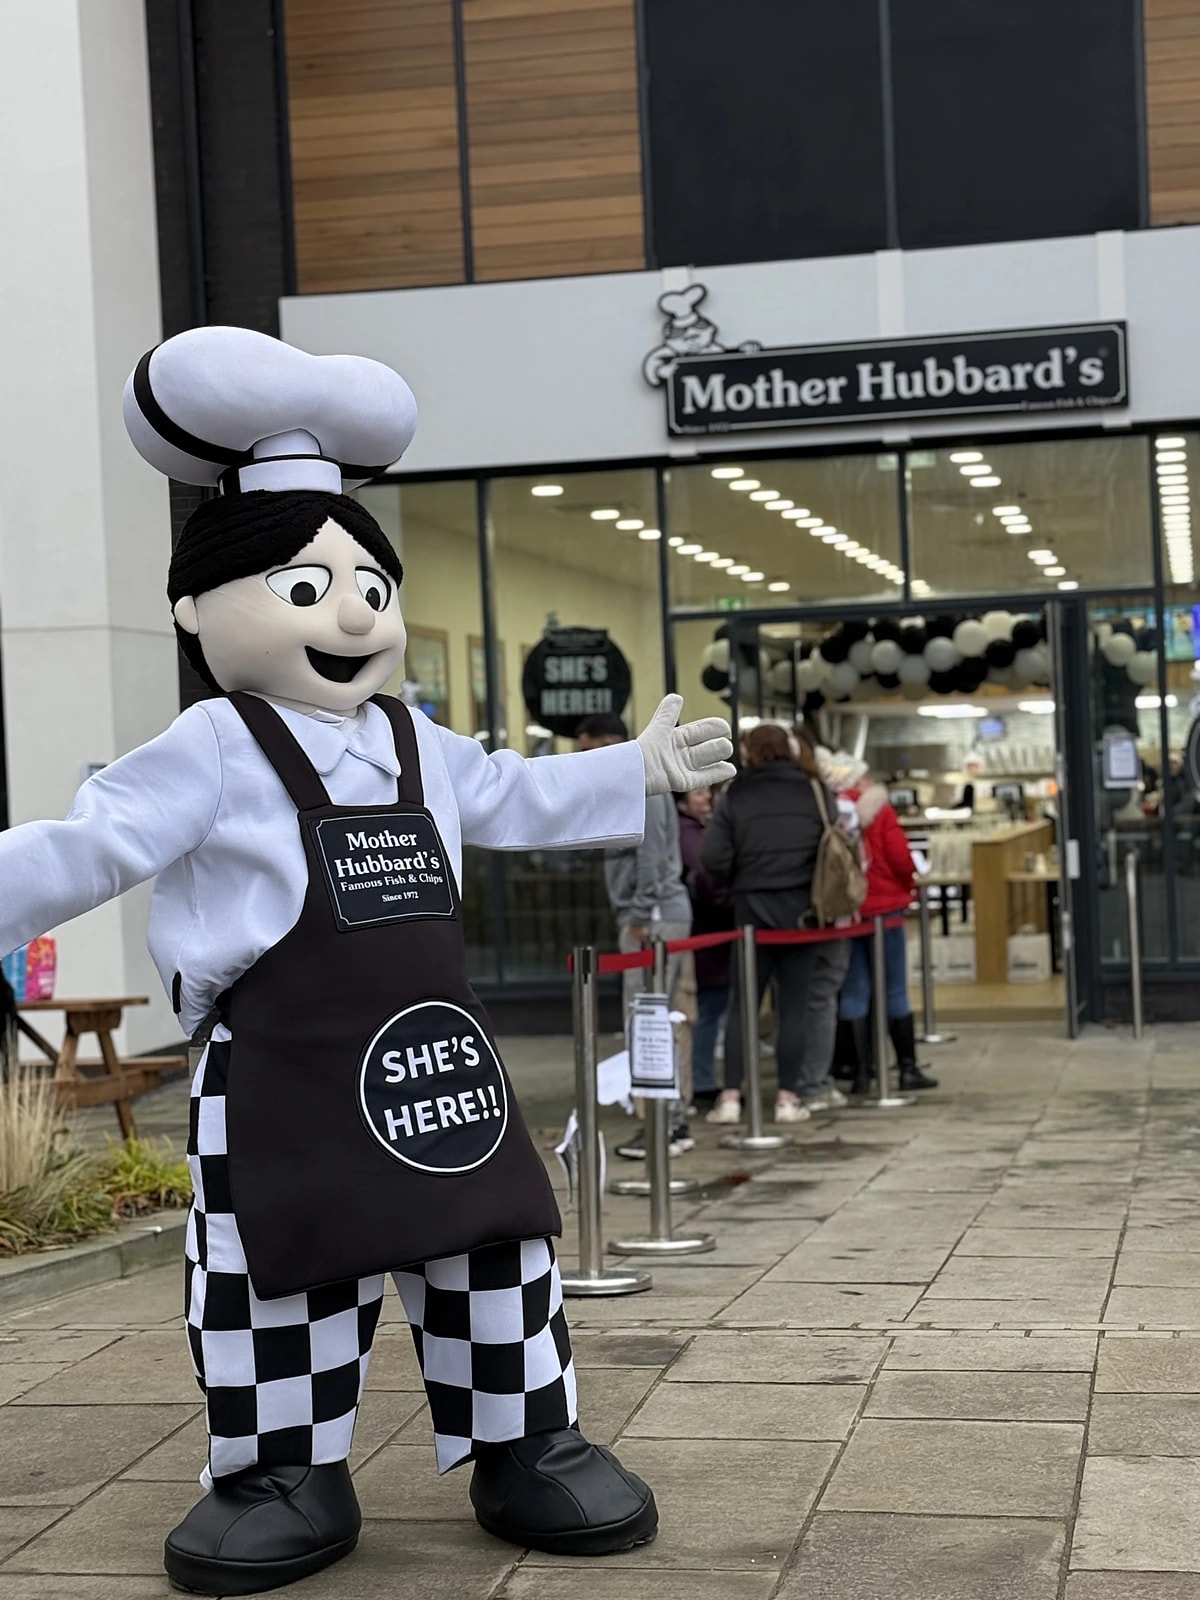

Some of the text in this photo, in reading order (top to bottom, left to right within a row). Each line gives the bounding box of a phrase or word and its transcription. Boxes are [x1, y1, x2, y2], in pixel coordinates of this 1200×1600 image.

[682, 347, 1105, 415] Mother Hubbard's
[345, 830, 417, 851] Mother
[334, 851, 440, 878] Hubbard's
[340, 873, 444, 892] Famous Fish & Chips
[382, 891, 419, 903] Since 1972
[382, 1035, 480, 1083] SHE'S
[383, 1085, 501, 1141] HERE!!
